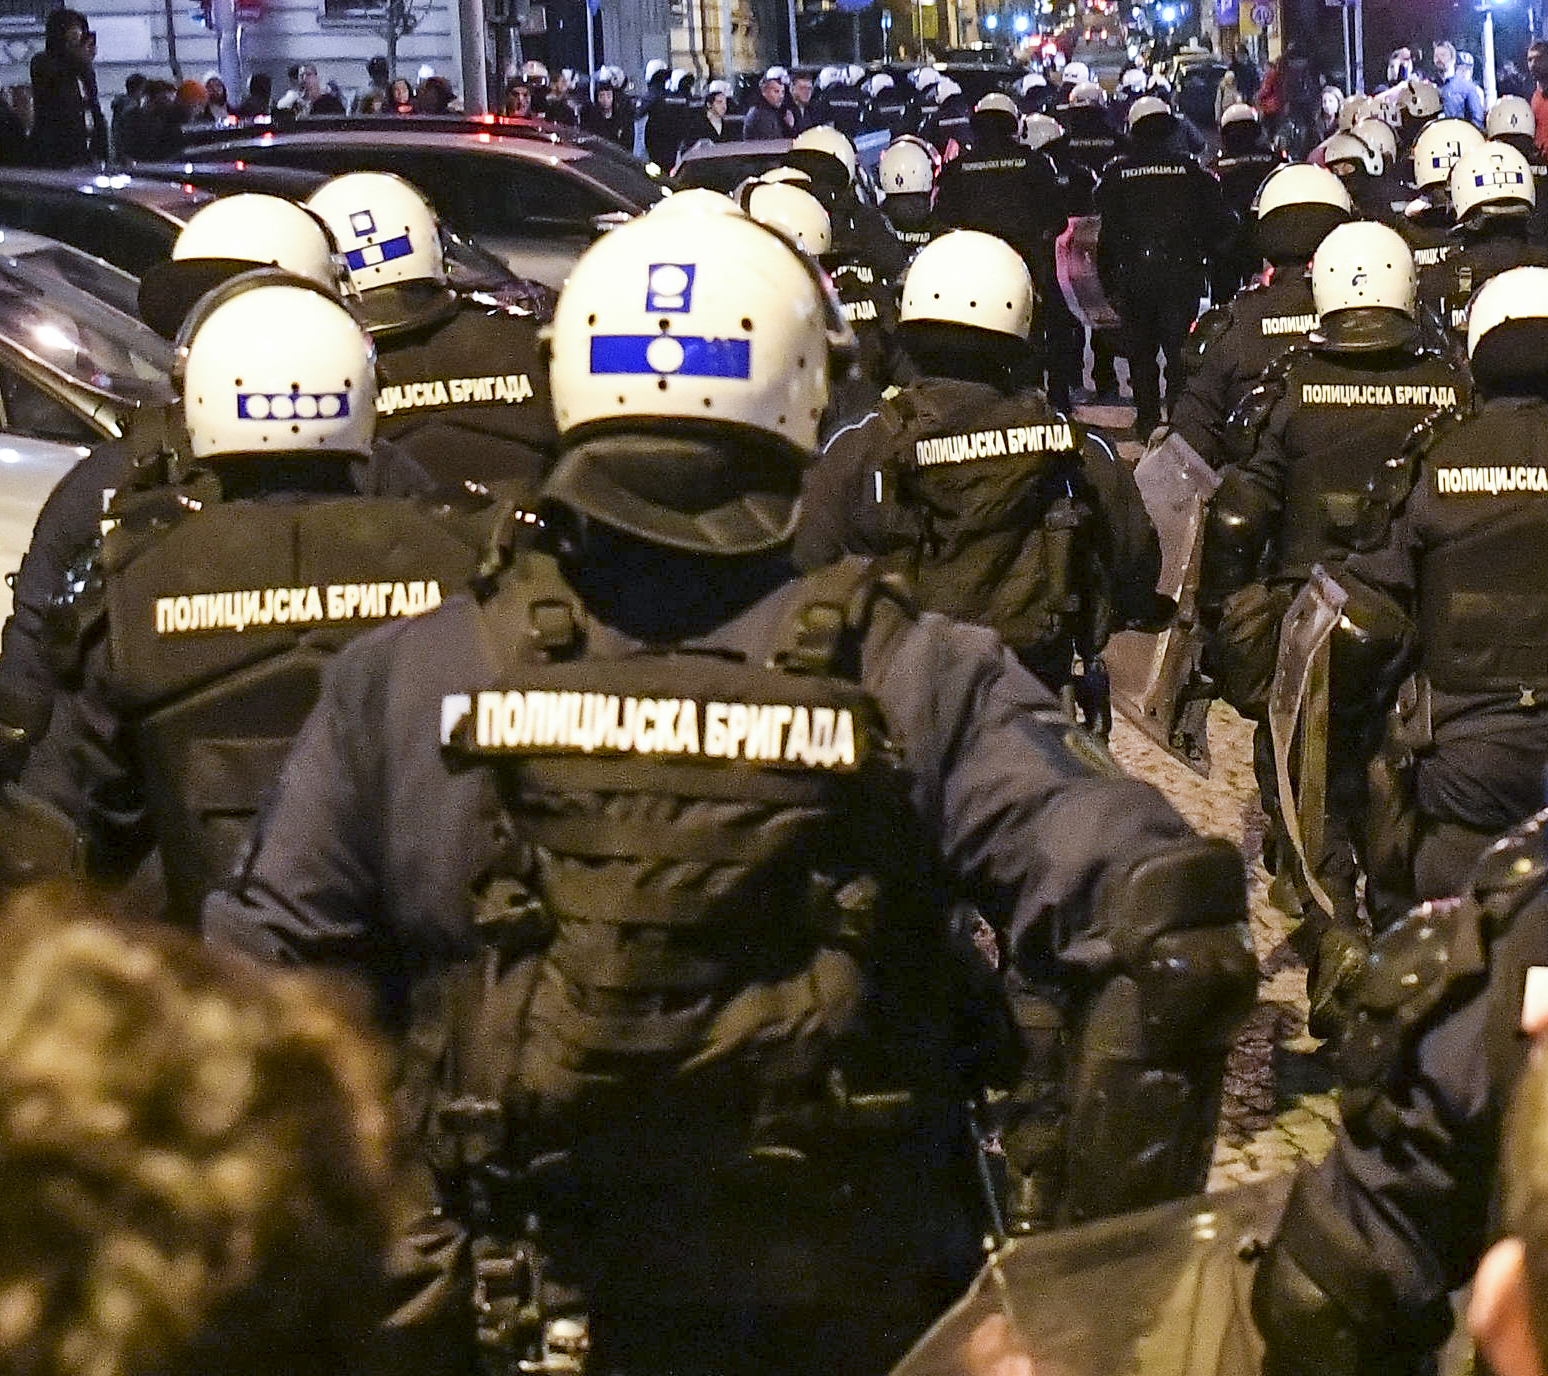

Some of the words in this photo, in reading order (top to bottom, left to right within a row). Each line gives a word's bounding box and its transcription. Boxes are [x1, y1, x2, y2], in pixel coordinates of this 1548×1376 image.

[1121, 165, 1187, 179] ПОЛИЦИЈА
[1261, 314, 1321, 335] ПОЛИЦИЈ
[376, 382, 448, 417] ЦИЈСКА
[450, 374, 535, 405] БРИГАДА
[1302, 384, 1393, 409] ПОЛИЦИЈСКА
[1395, 385, 1457, 408] БРИГАДА
[915, 428, 1007, 466] ПОЛИЦИЈСКА
[1007, 423, 1073, 455] БРИГАДА
[1437, 466, 1548, 496] ПОЛИЦИЈСКА
[156, 586, 322, 634] ПОЛИЦИЈСКА
[326, 580, 442, 620] БРИГАДА
[476, 691, 700, 756] ПОЛИЦИЈСКА
[703, 701, 856, 766] БРИГАДА
